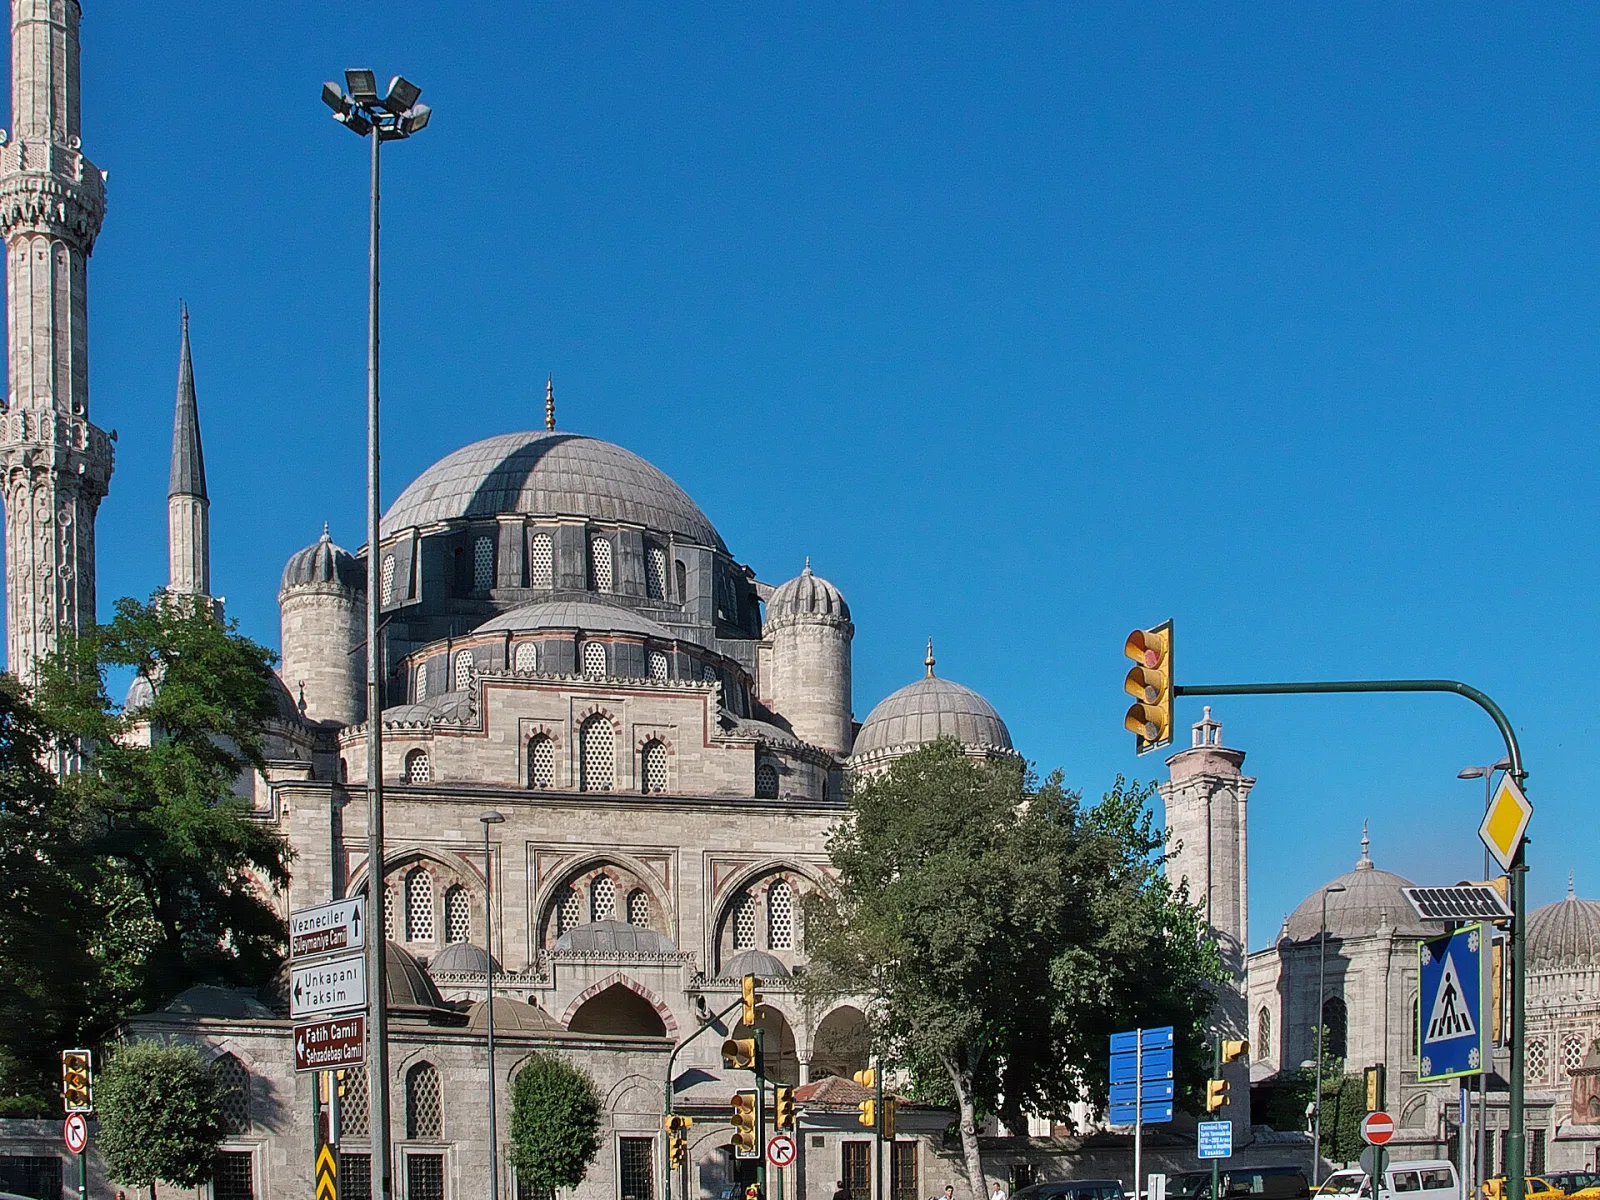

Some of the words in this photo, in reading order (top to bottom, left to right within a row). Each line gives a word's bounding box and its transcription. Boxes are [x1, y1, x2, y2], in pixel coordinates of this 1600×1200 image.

[292, 910, 344, 932] Vezneciler
[305, 968, 357, 987] Unkapanı
[305, 988, 346, 1006] Taksim
[306, 1025, 329, 1044] Fatih
[331, 1022, 358, 1041] Camii
[306, 1045, 343, 1066] Şehzadebaşı
[343, 1042, 362, 1059] Camii
